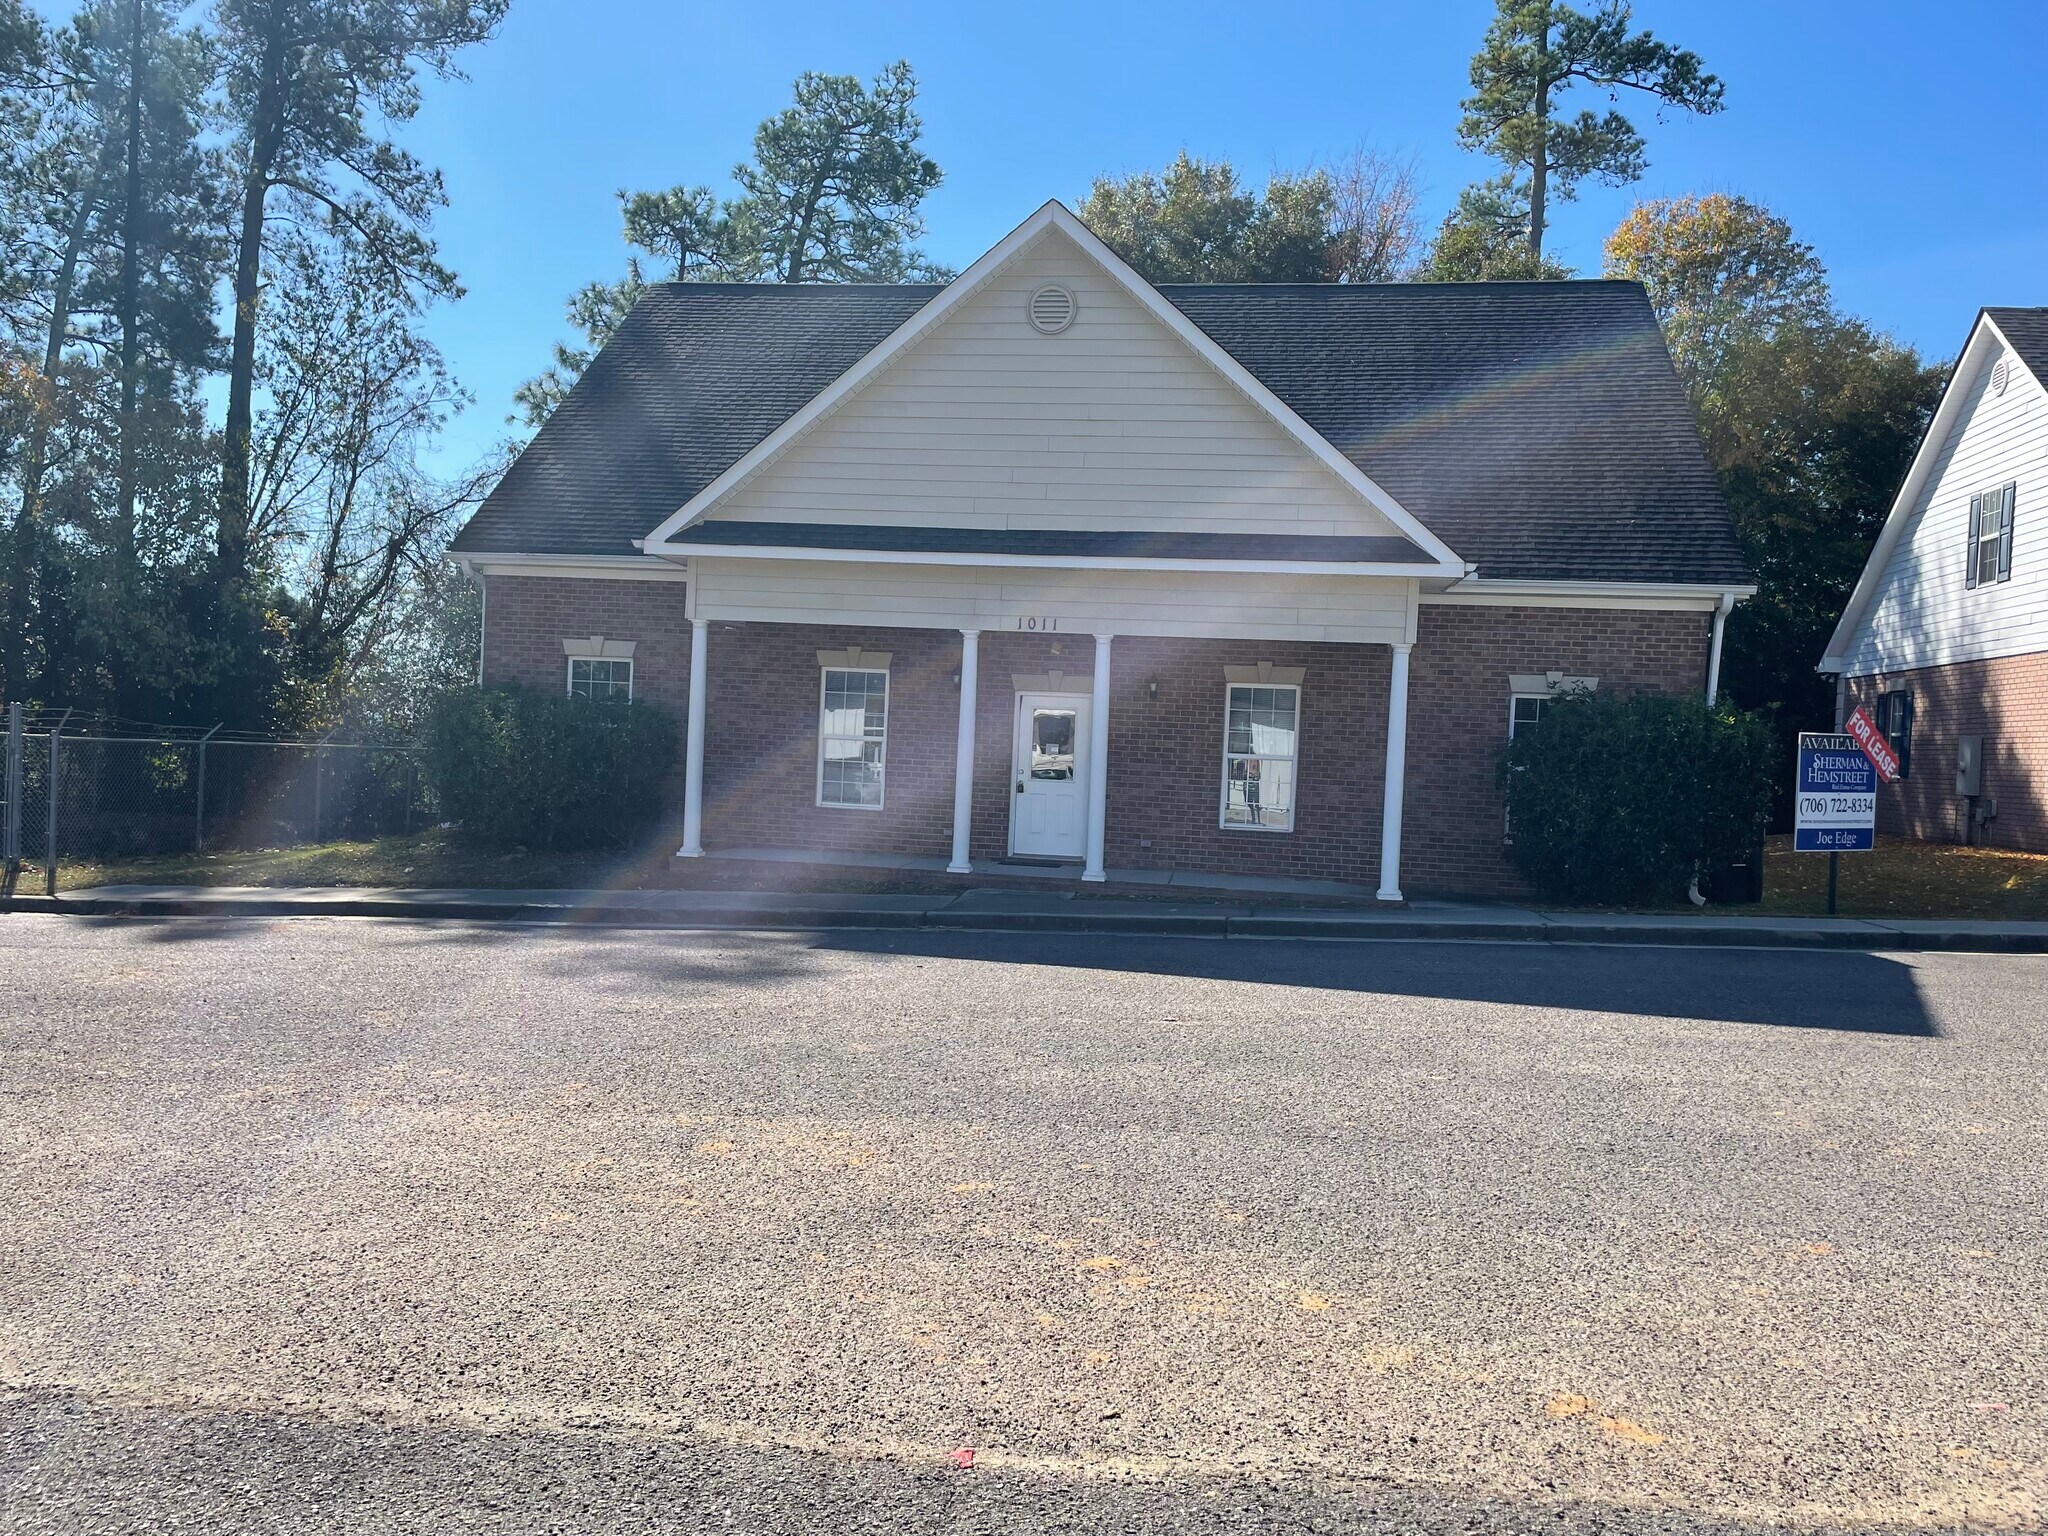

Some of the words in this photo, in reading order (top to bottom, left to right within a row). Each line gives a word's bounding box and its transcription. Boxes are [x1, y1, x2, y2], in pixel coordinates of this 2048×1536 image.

[1017, 617, 1057, 631] 1011
[1802, 737, 1863, 750] AVAILAB
[1849, 712, 1871, 743] FOR
[1867, 735, 1896, 778] LEASE
[1863, 761, 1869, 770] &
[1800, 798, 1828, 816] (706)
[1831, 798, 1873, 812] 722-8334
[1817, 831, 1833, 844] Joe
[1835, 831, 1857, 847] Edge
